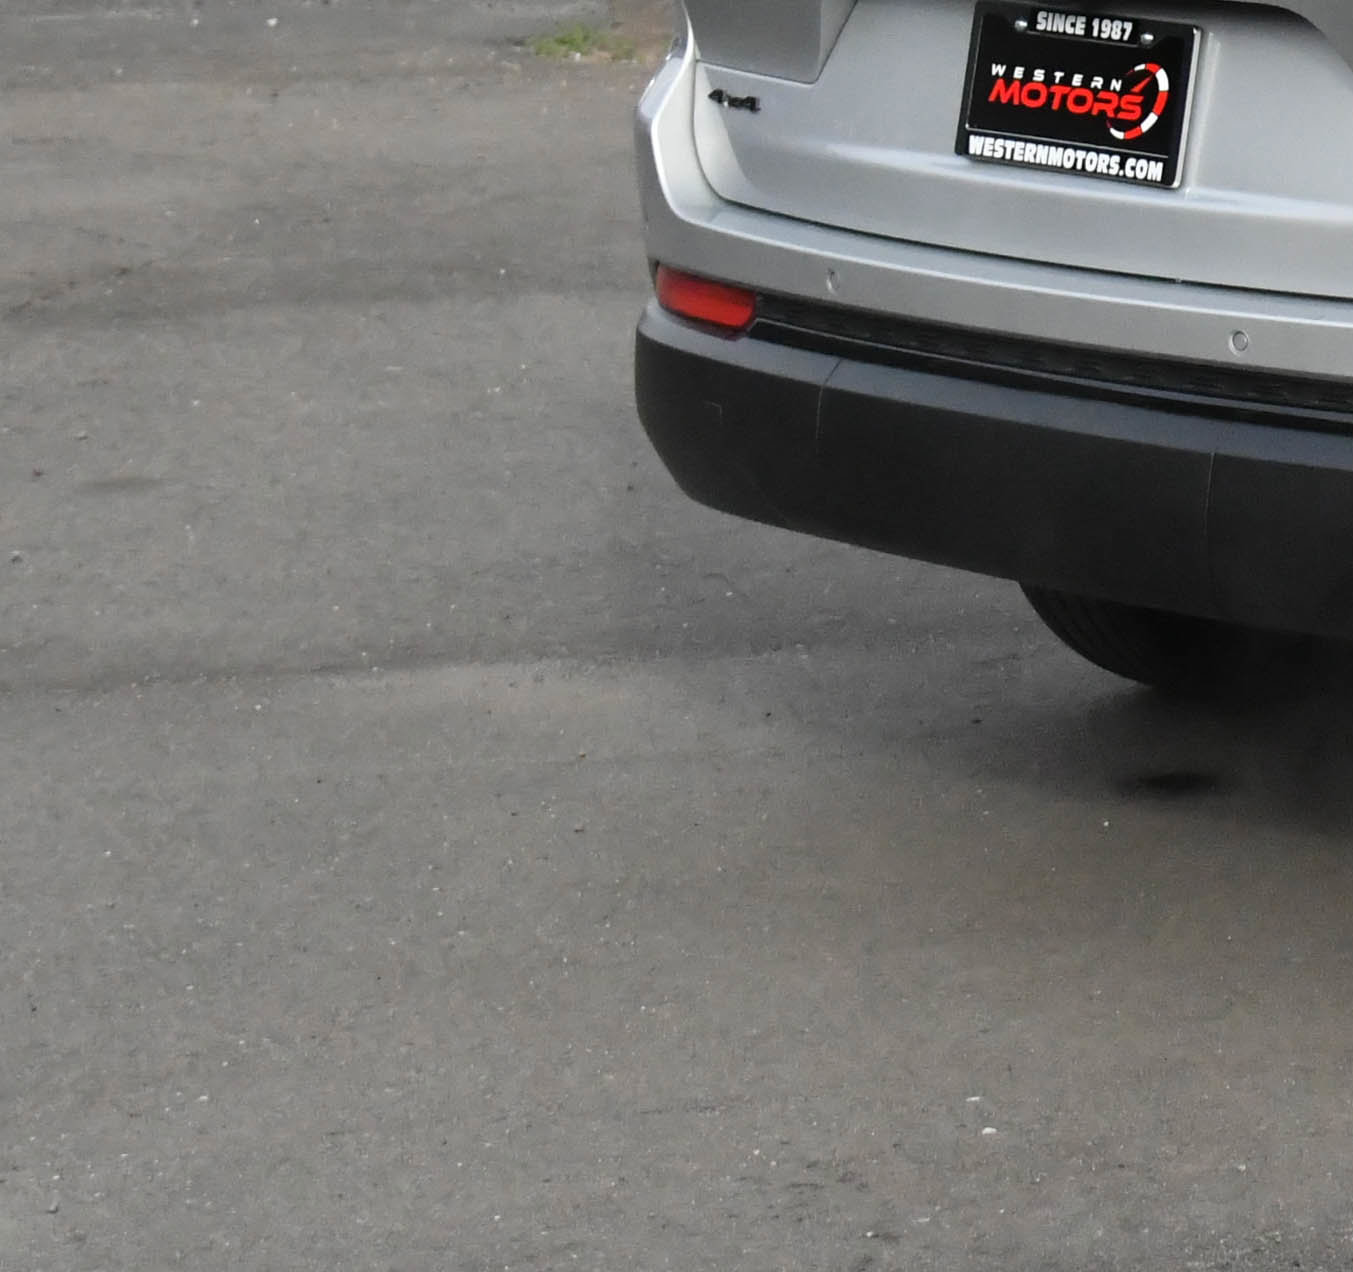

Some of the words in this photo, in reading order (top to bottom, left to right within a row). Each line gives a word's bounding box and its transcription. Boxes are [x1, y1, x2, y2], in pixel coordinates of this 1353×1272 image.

[1036, 11, 1087, 36] SINCE
[1092, 18, 1133, 41] 1987
[991, 63, 1123, 91] WESTERN
[988, 78, 1144, 121] MOTORS
[968, 134, 1164, 182] WESTERNMOTORS.COM
